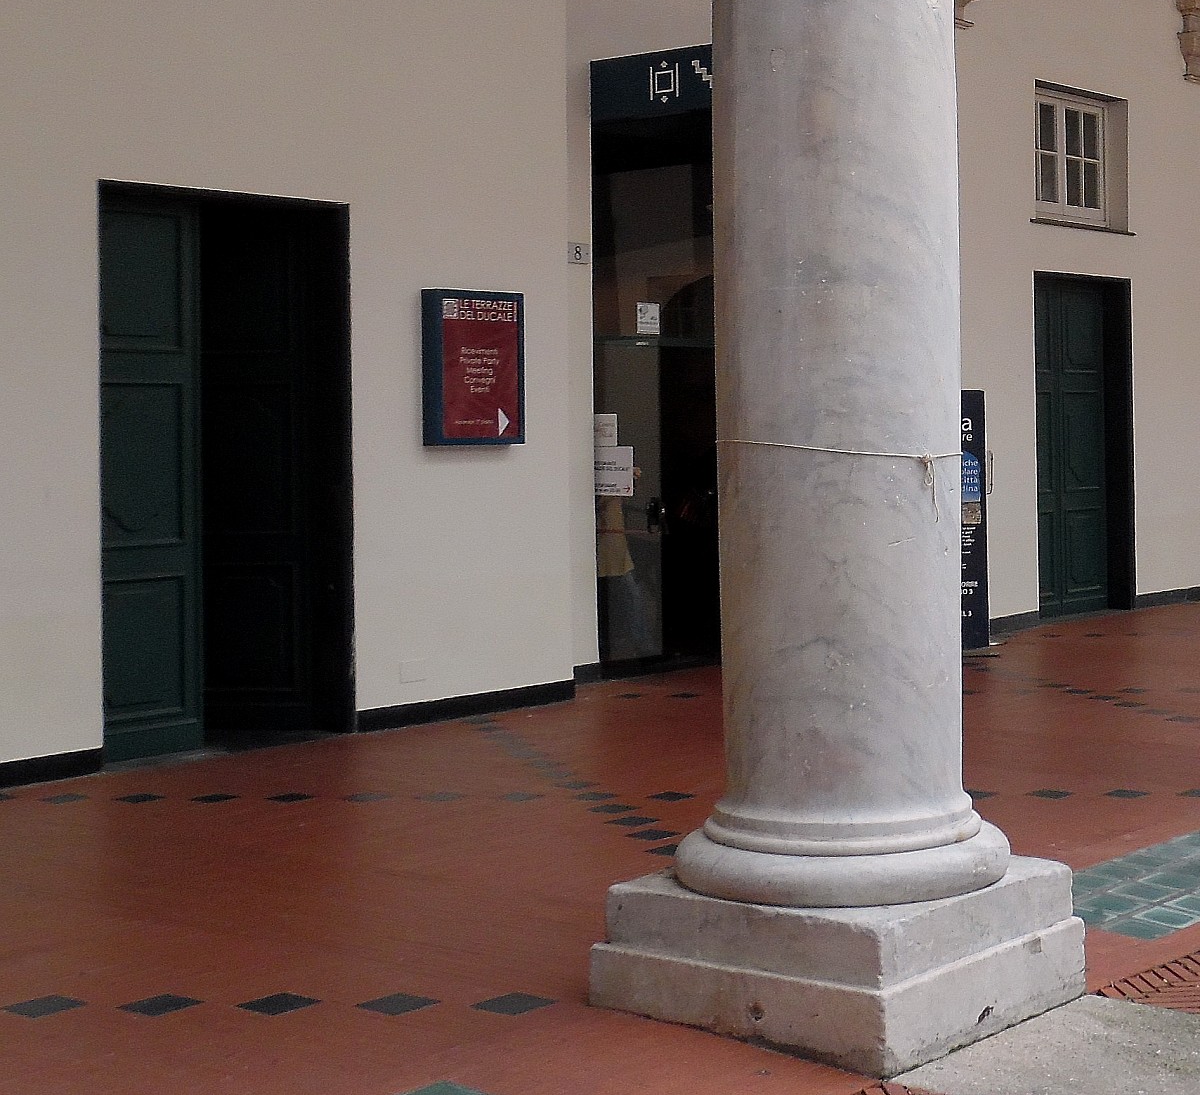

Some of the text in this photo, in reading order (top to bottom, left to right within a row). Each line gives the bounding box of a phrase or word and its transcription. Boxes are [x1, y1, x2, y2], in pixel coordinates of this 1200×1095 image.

[574, 245, 582, 261] 8
[460, 299, 513, 311] LE TERRAZZE
[460, 310, 513, 322] DEL DUCALE
[459, 356, 499, 365] Private Party
[466, 366, 493, 376] Meeting
[464, 375, 497, 385] Convegni
